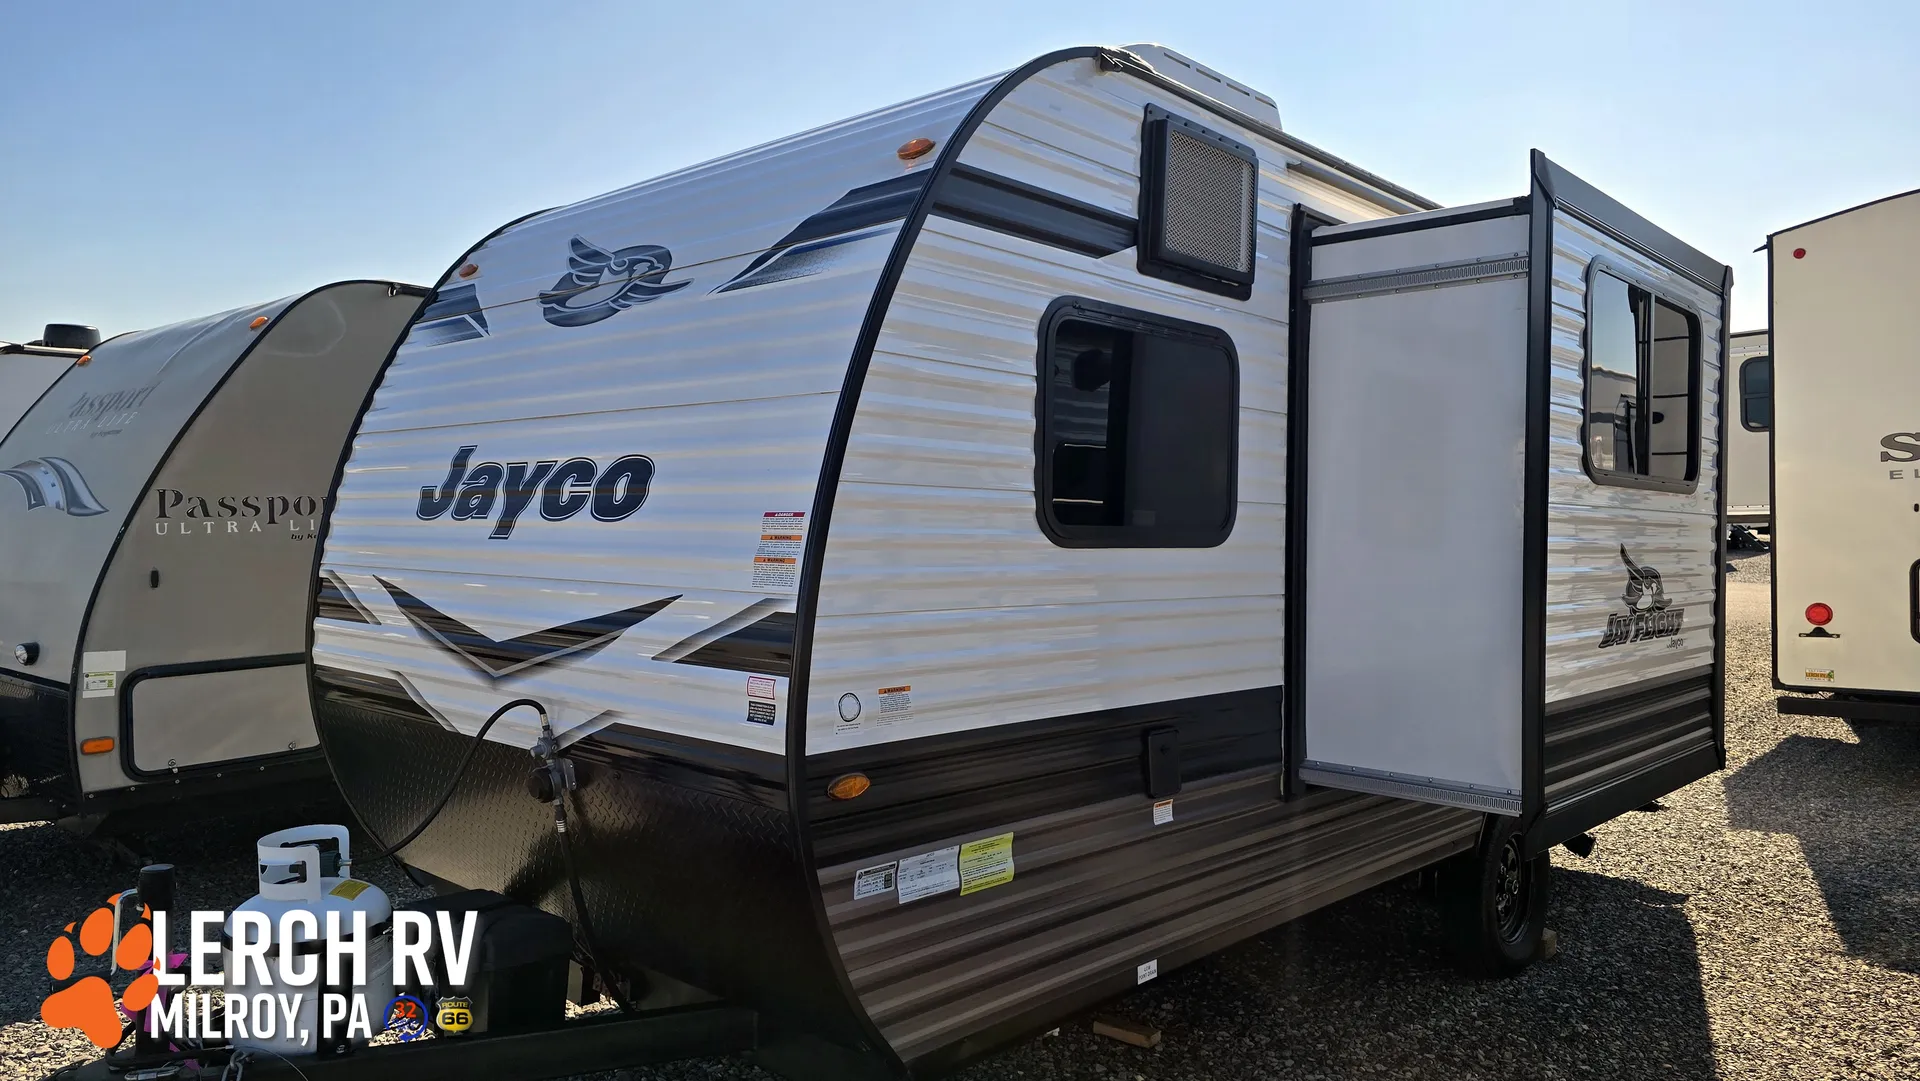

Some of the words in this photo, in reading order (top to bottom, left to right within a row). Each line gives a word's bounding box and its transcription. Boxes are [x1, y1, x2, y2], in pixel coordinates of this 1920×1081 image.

[97, 411, 138, 428] LITE
[416, 445, 656, 540] Jayco
[155, 488, 327, 525] Passpo
[155, 521, 262, 536] ULTRA
[289, 519, 317, 531] LI
